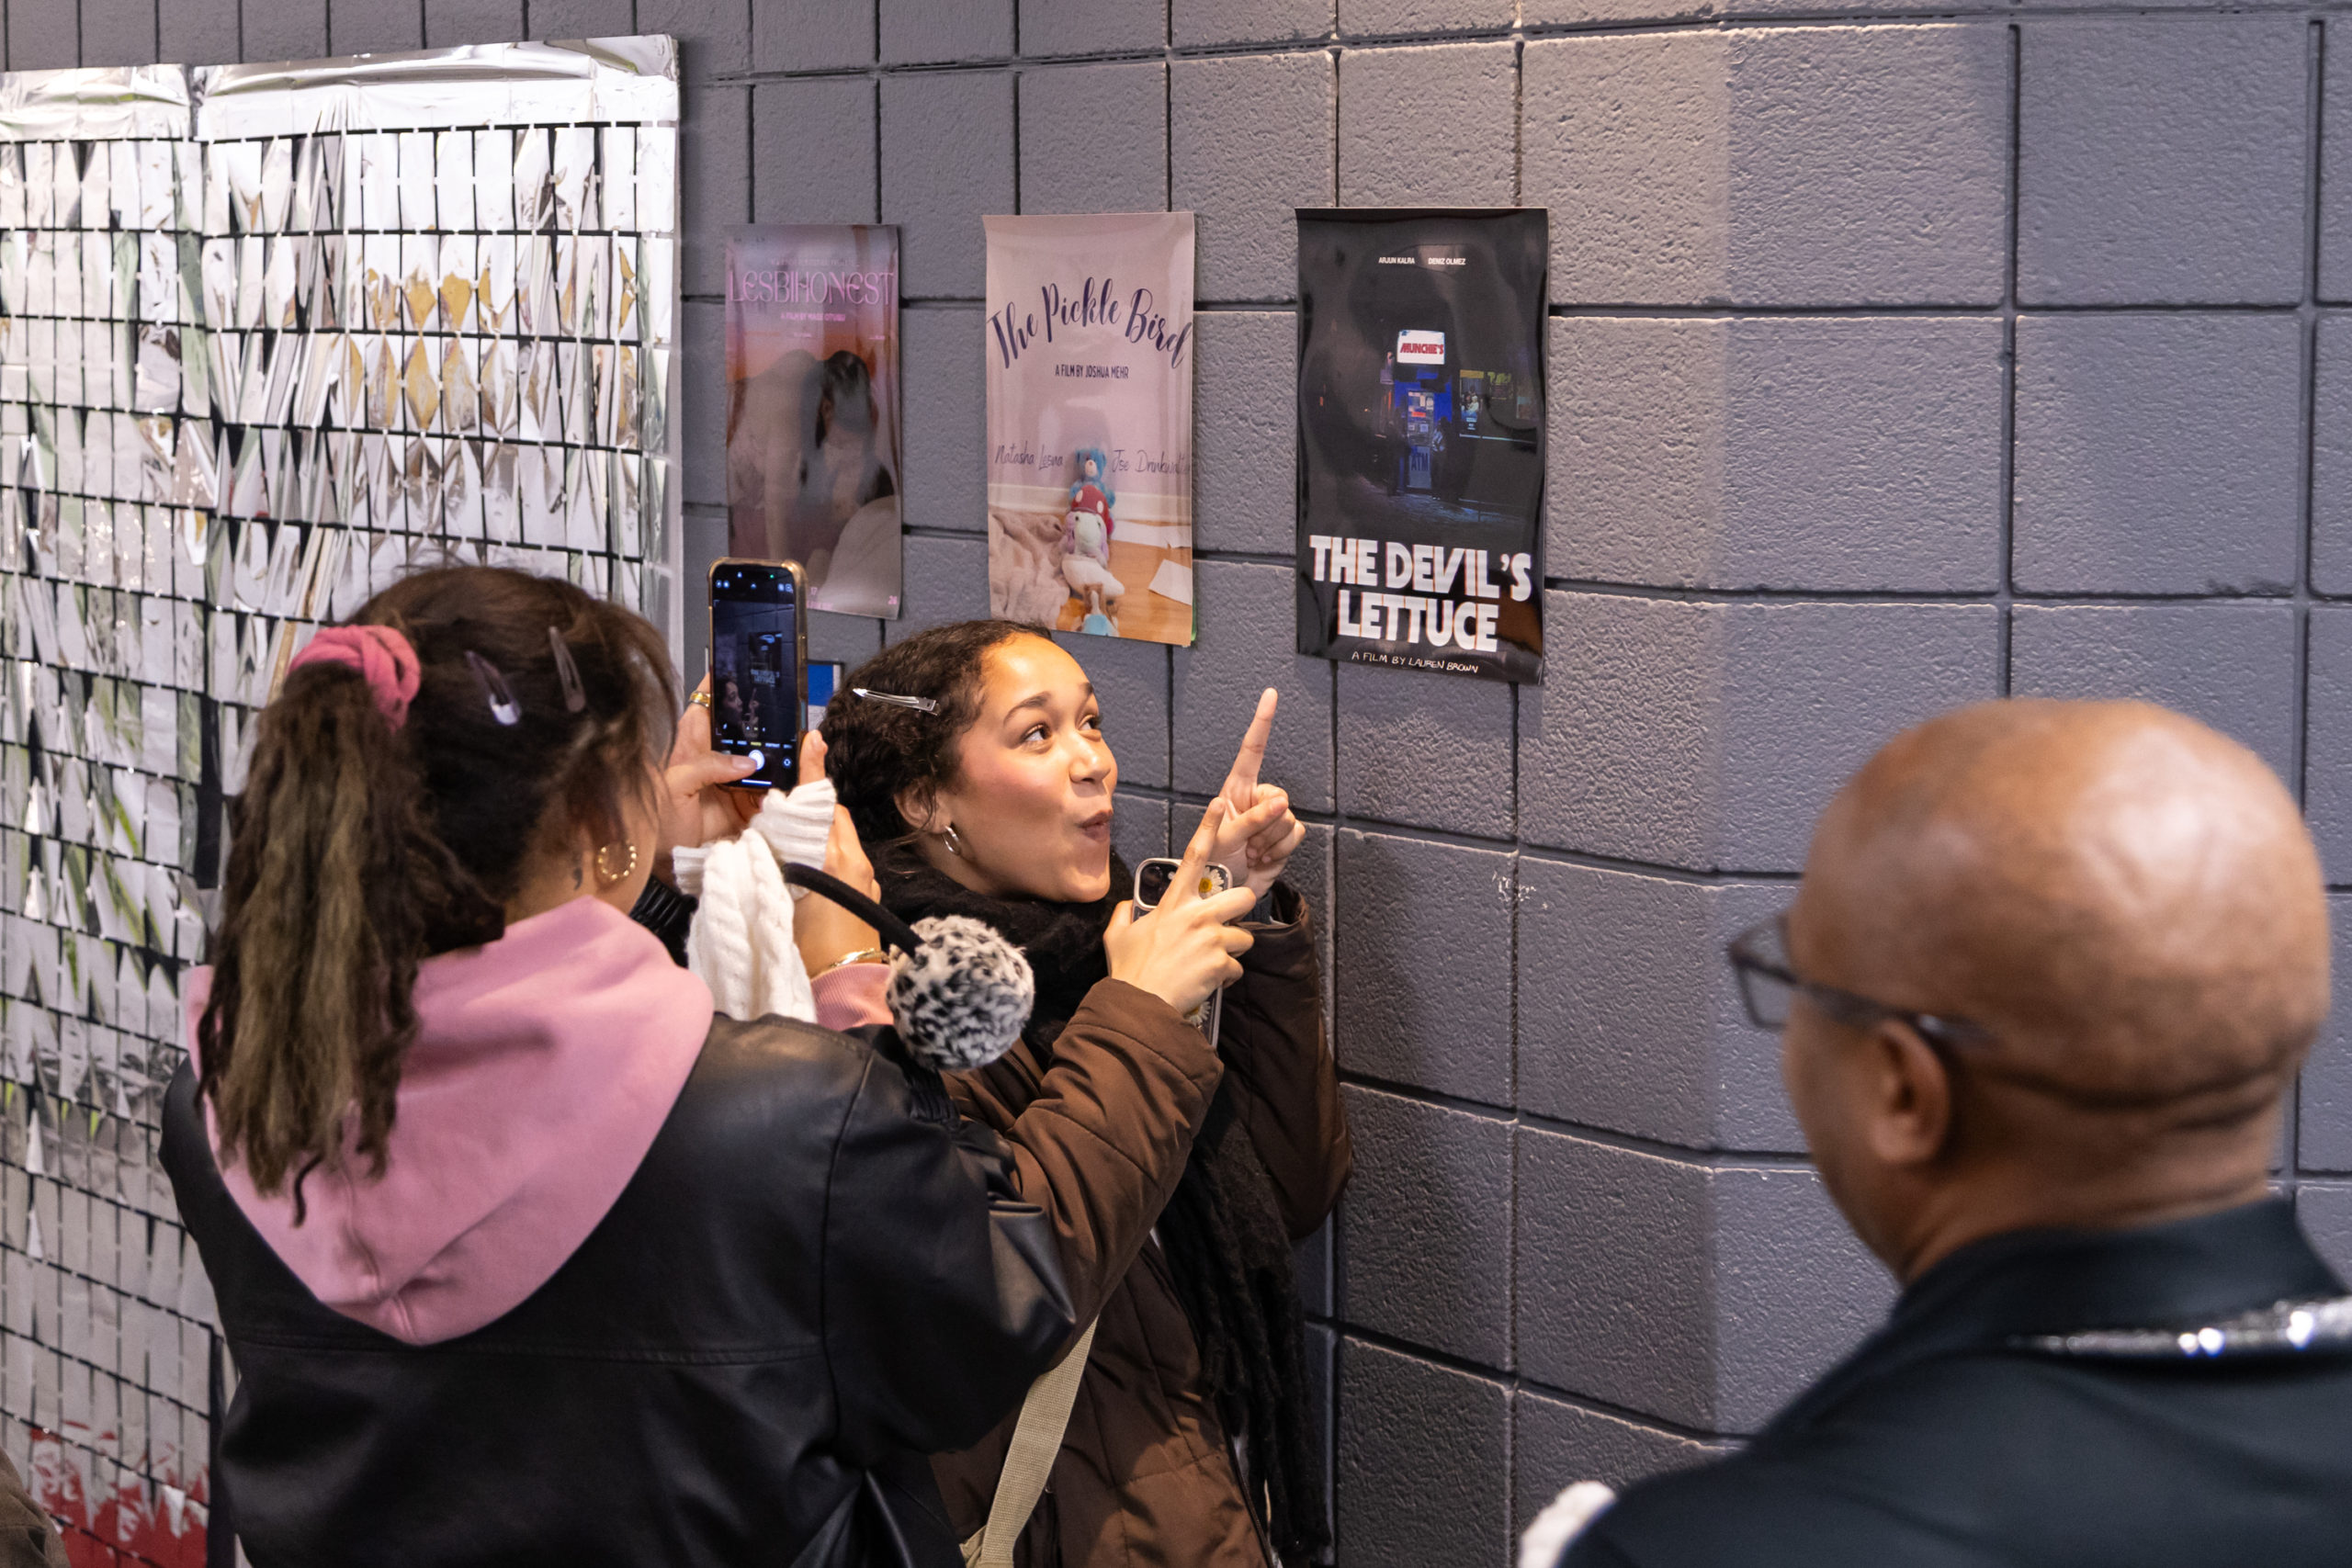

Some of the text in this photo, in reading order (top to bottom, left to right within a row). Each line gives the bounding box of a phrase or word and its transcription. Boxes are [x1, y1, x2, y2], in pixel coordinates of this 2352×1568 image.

[1378, 256, 1415, 265] ARJUN KALRA
[988, 276, 1193, 369] The Pickle Bird
[1055, 364, 1130, 379] A FILM BY JOSHUA MEHR
[994, 440, 1035, 465] Natasha
[1309, 535, 1378, 586] THE
[1337, 589, 1500, 652] LETTUCE
[1351, 651, 1479, 674] A FILM BY LAUREN BROWN
